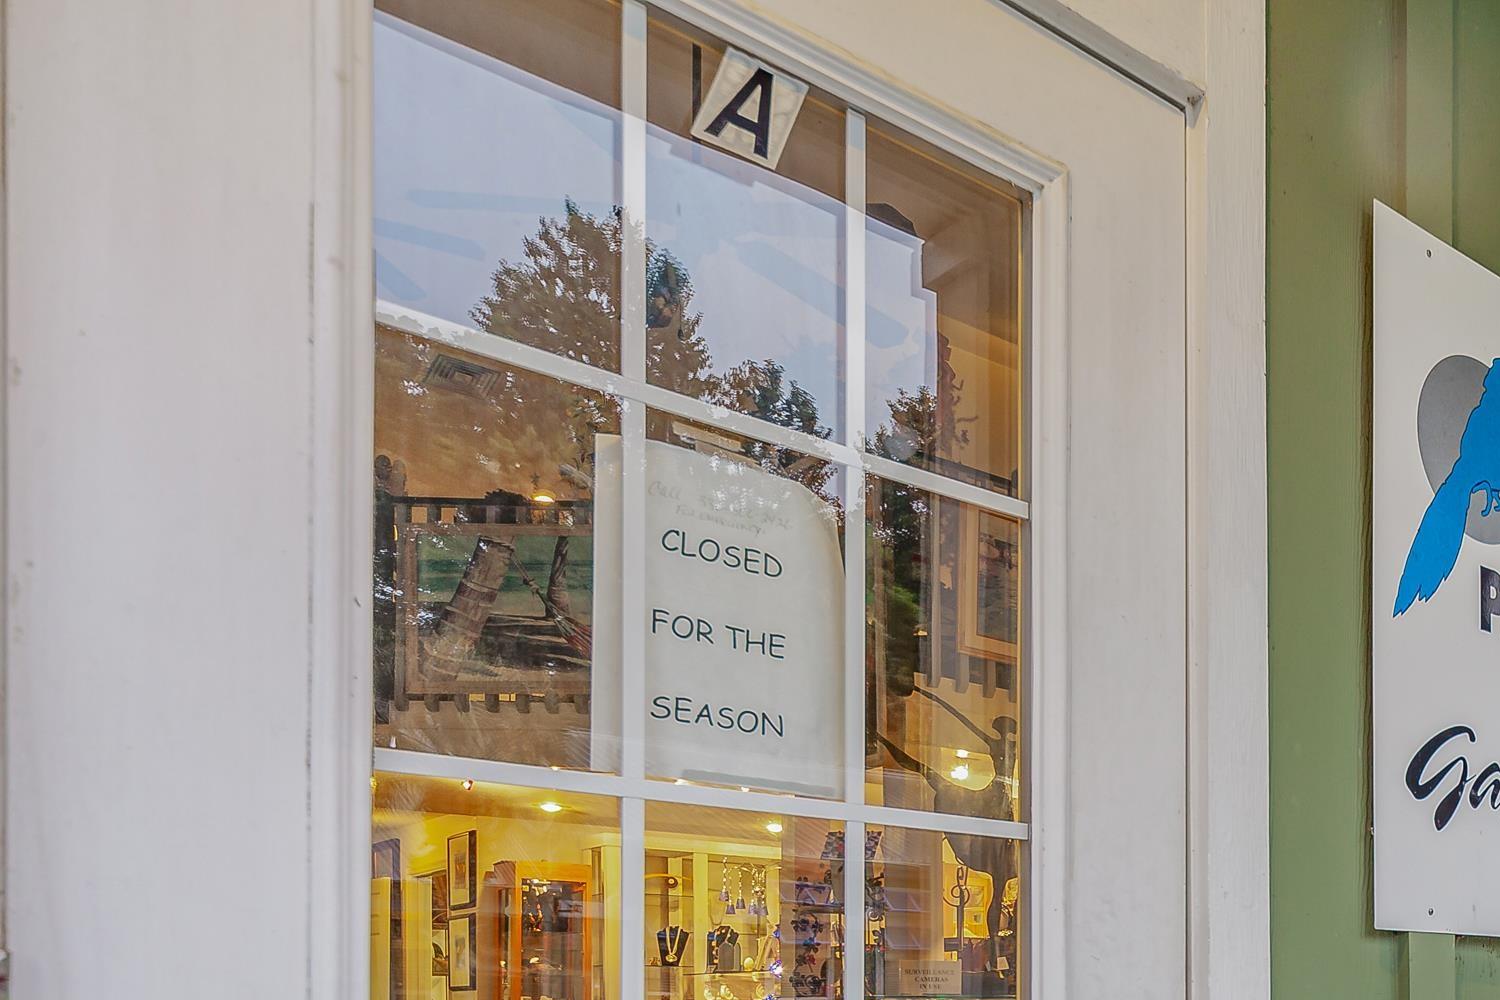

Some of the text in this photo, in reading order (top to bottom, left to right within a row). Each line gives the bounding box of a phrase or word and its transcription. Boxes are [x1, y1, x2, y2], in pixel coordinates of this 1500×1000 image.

[703, 67, 775, 160] A
[661, 529, 783, 578] CLOSED
[652, 608, 786, 659] FOR THE
[650, 696, 784, 738] SEASON
